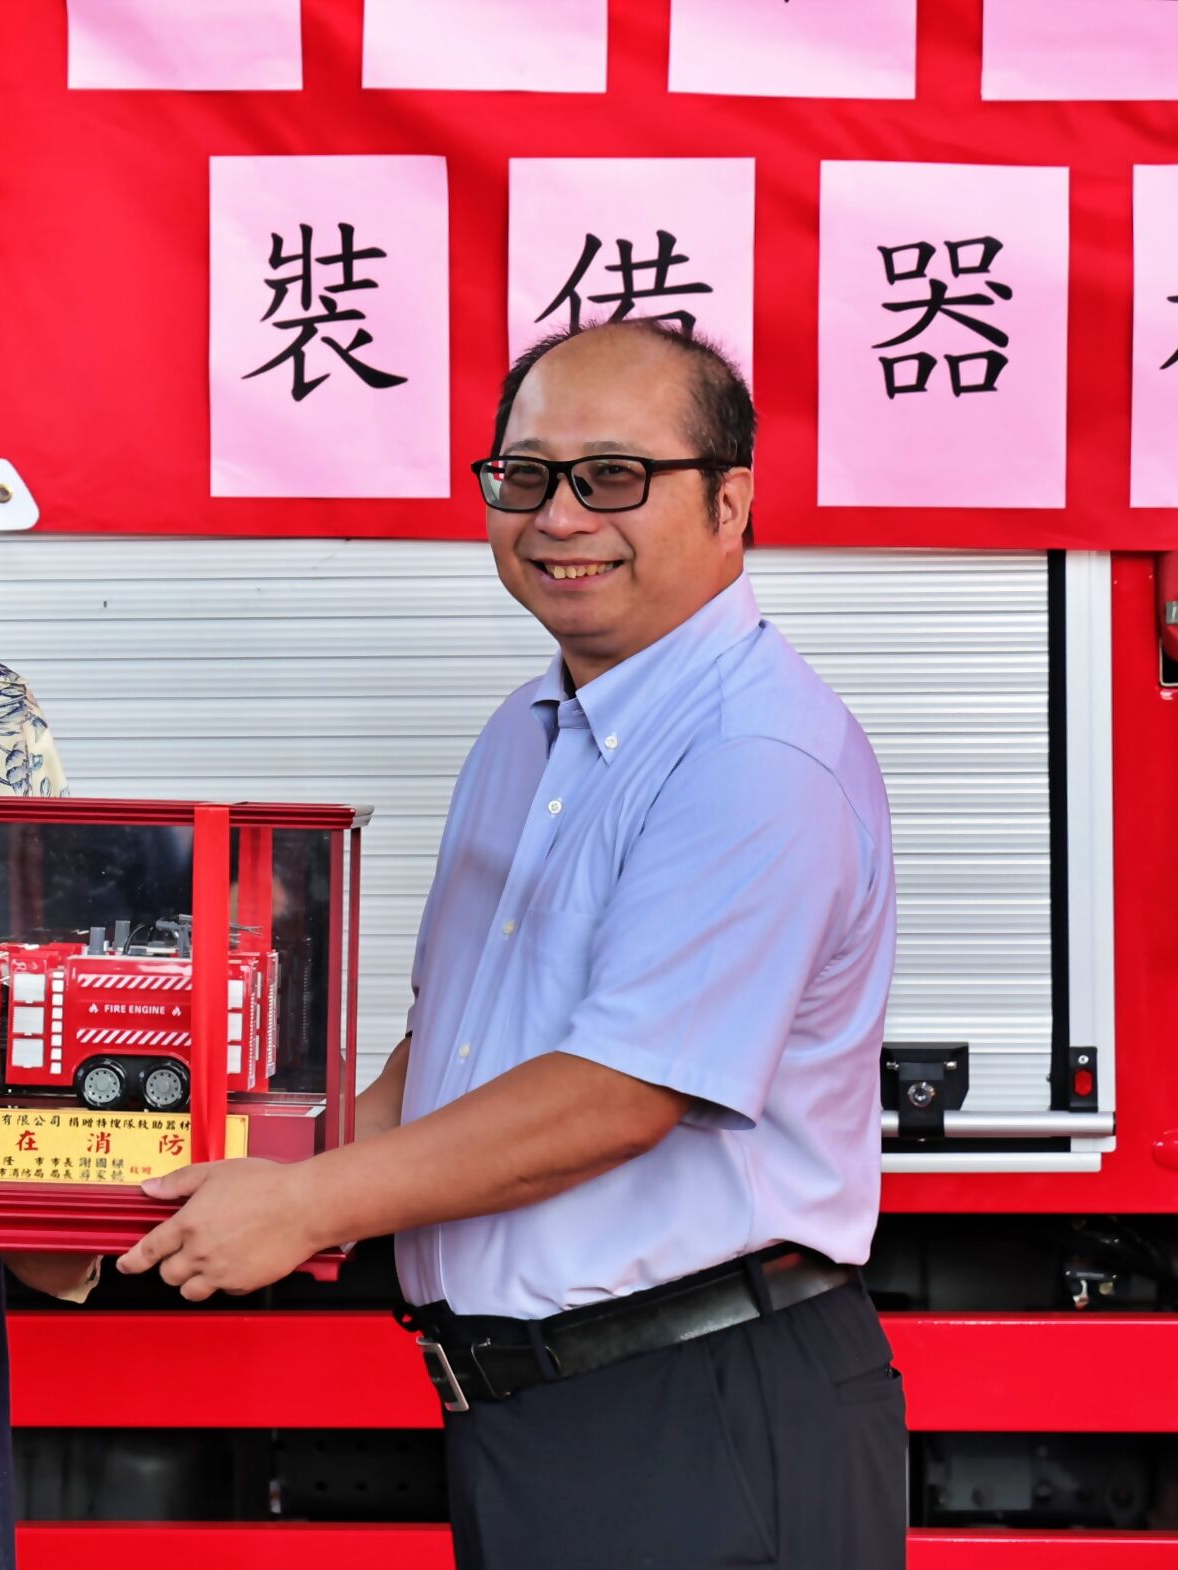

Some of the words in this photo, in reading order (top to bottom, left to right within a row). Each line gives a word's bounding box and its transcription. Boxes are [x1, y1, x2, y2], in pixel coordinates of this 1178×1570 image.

[240, 221, 1178, 402] 裝備器
[104, 1004, 127, 1014] FIRE
[128, 1005, 166, 1015] ENGINE
